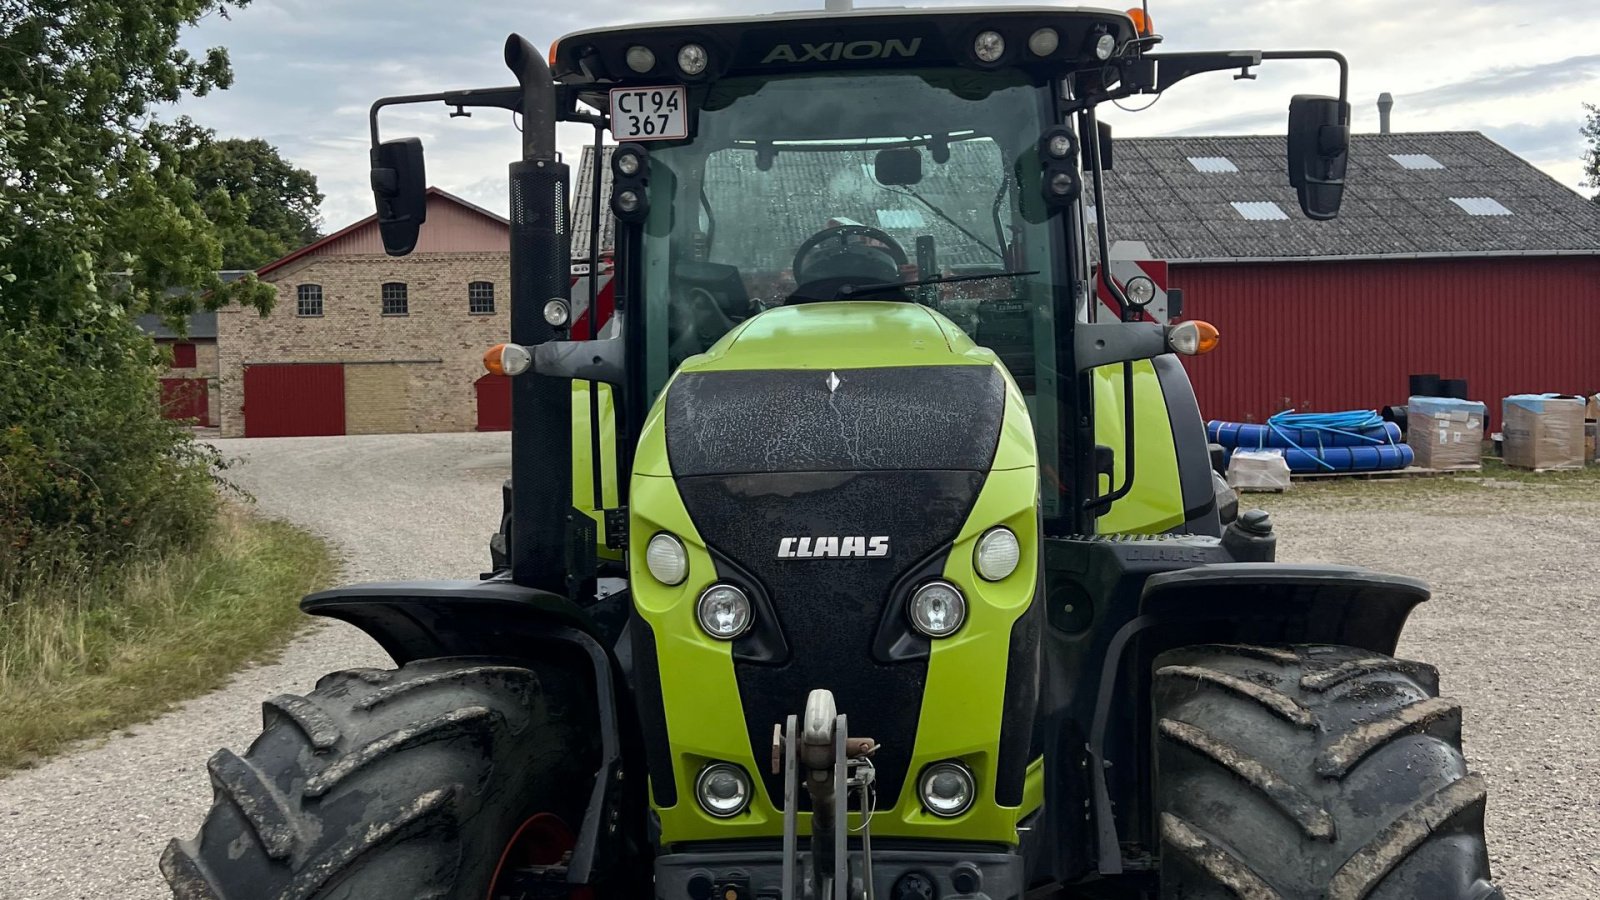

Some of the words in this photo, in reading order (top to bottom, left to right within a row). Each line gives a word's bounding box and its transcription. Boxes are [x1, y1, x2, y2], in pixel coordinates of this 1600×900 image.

[760, 37, 922, 63] AXION
[618, 90, 678, 113] CT94
[629, 114, 669, 136] 367
[777, 536, 889, 557] CLAAS
[1126, 547, 1205, 562] CLAAS
